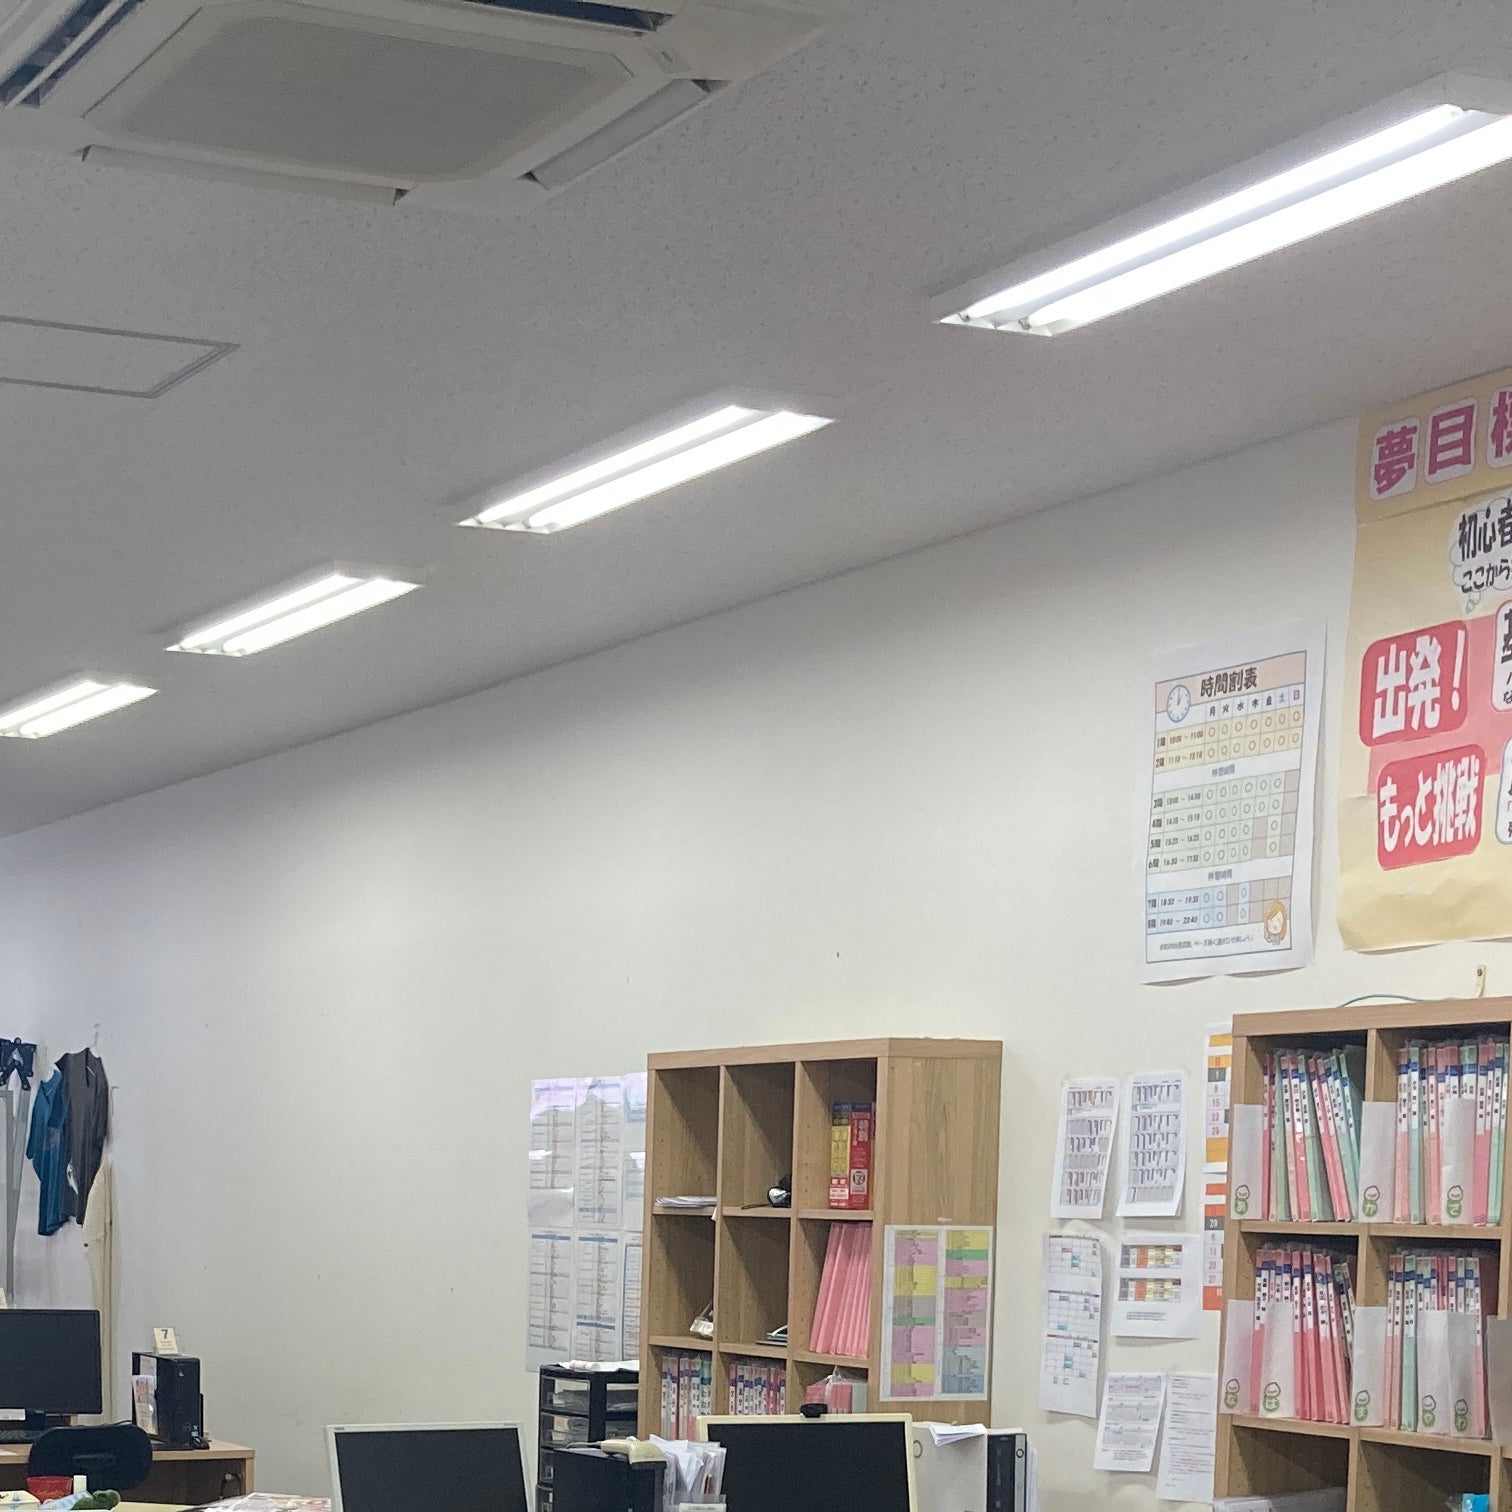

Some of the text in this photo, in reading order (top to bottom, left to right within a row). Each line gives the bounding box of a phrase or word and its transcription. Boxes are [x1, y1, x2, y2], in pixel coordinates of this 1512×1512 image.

[1200, 666, 1258, 698] 時間割表
[1380, 755, 1480, 852] もっと挑戦
[160, 1329, 168, 1339] 7
